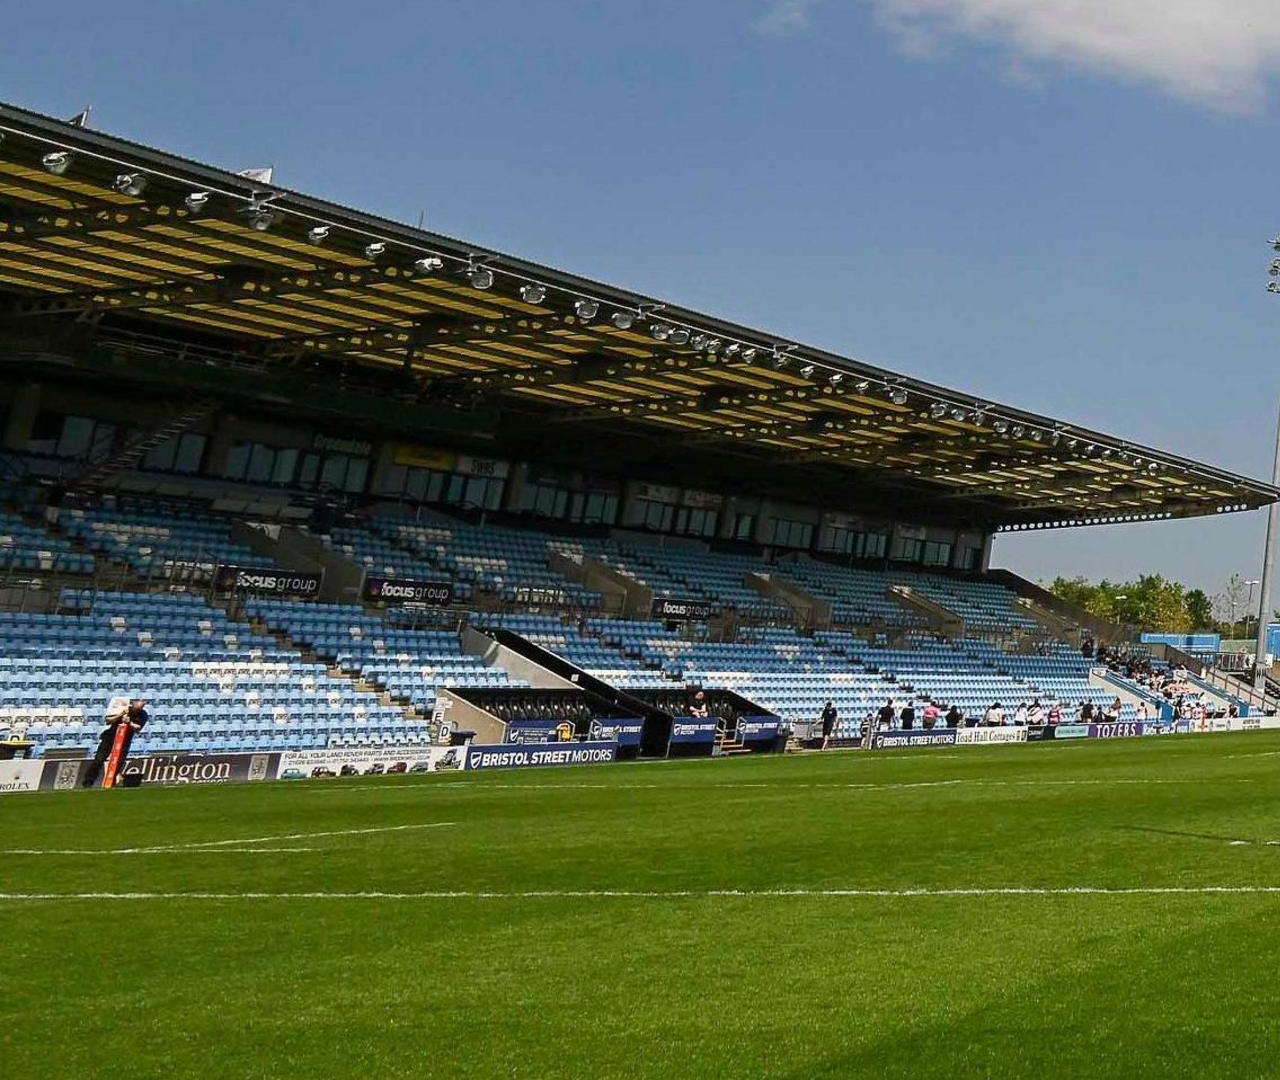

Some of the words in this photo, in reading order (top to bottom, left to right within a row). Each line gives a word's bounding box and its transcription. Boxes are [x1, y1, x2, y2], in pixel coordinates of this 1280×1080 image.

[441, 726, 449, 738] D
[974, 730, 988, 743] Hall
[988, 729, 1015, 743] Cottages
[1096, 724, 1136, 738] TOZERS
[882, 735, 908, 747] BRISTOL
[909, 735, 932, 746] STREET
[932, 733, 954, 745] MOTORS
[298, 752, 309, 760] ALL
[310, 751, 326, 759] YOUR
[326, 751, 343, 759] LAND
[343, 750, 362, 758] ROVER
[363, 749, 382, 757] PARTS
[481, 752, 529, 767] BRISTOL
[531, 750, 572, 764] STREET
[572, 748, 613, 762] MOTORS
